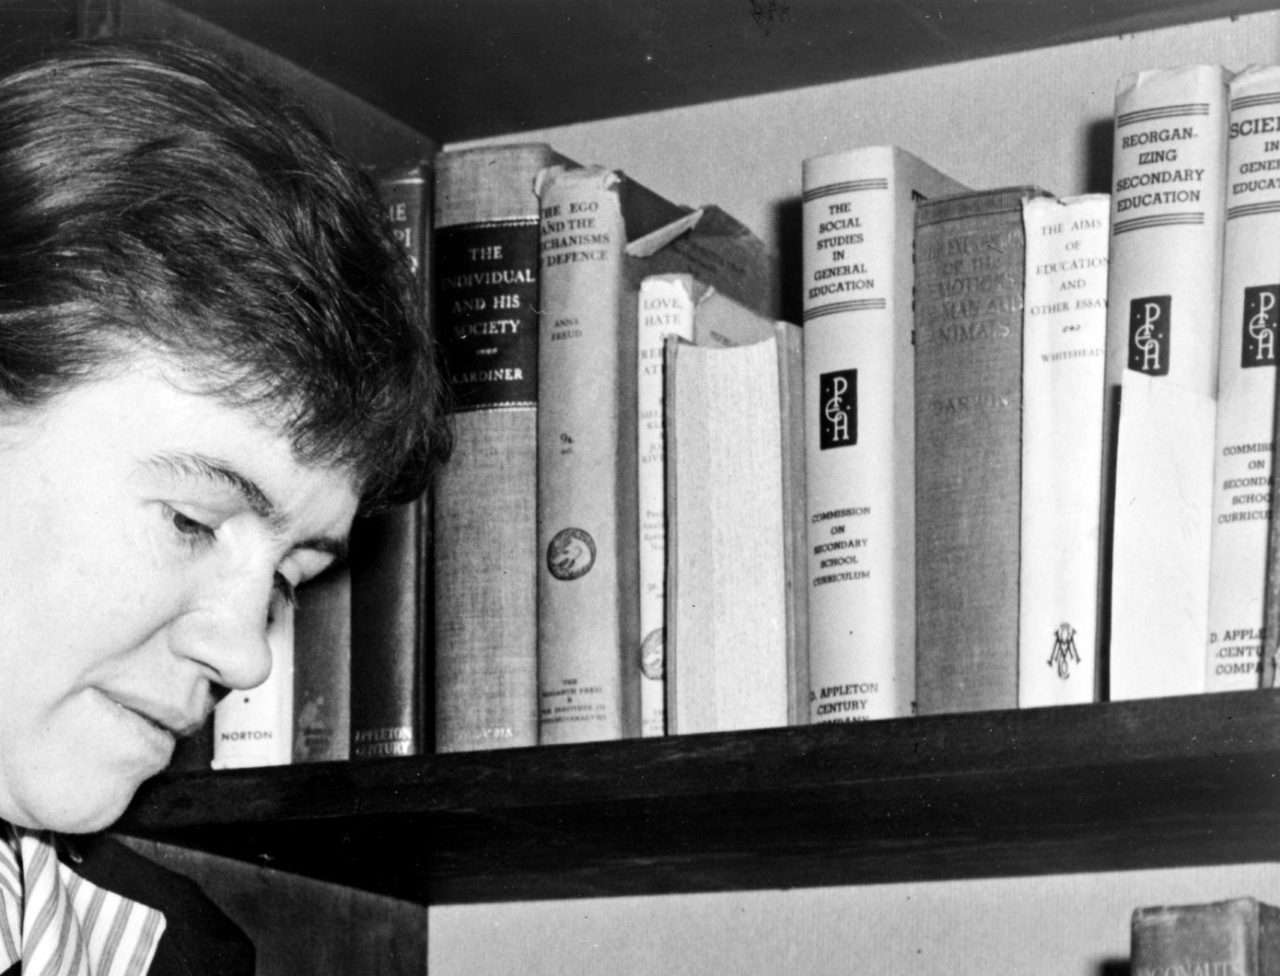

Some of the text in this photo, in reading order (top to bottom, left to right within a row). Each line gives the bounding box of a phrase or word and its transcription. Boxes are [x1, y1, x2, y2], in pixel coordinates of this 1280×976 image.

[1138, 148, 1178, 165] IZING
[1116, 168, 1205, 193] SECONDARY
[570, 202, 599, 214] EGO
[828, 202, 851, 215] THE
[1117, 190, 1201, 212] EDUCATION
[568, 218, 596, 231] THE
[819, 217, 862, 233] SOCIAL
[1041, 219, 1103, 236] THE AIMS
[816, 233, 864, 250] STUDIES
[1065, 240, 1081, 251] OF
[470, 246, 503, 260] THE
[832, 250, 845, 261] IN
[440, 268, 536, 290] INDIVIDUAL
[813, 264, 868, 281] GENERAL
[808, 279, 875, 299] EDUCATION
[1059, 279, 1086, 291] AND
[452, 294, 521, 313] AND HIS
[1030, 301, 1070, 316] OTHER
[645, 314, 680, 327] HATE
[1248, 460, 1265, 470] ON
[811, 507, 871, 523] COMMISSION
[830, 525, 845, 535] ON
[814, 538, 869, 555] SECONDARY
[820, 555, 858, 569] SCHOOL
[813, 570, 870, 587] CURRICULUM
[820, 683, 878, 699] APPLETON
[817, 700, 868, 716] CENTURY
[221, 730, 273, 742] NORTON
